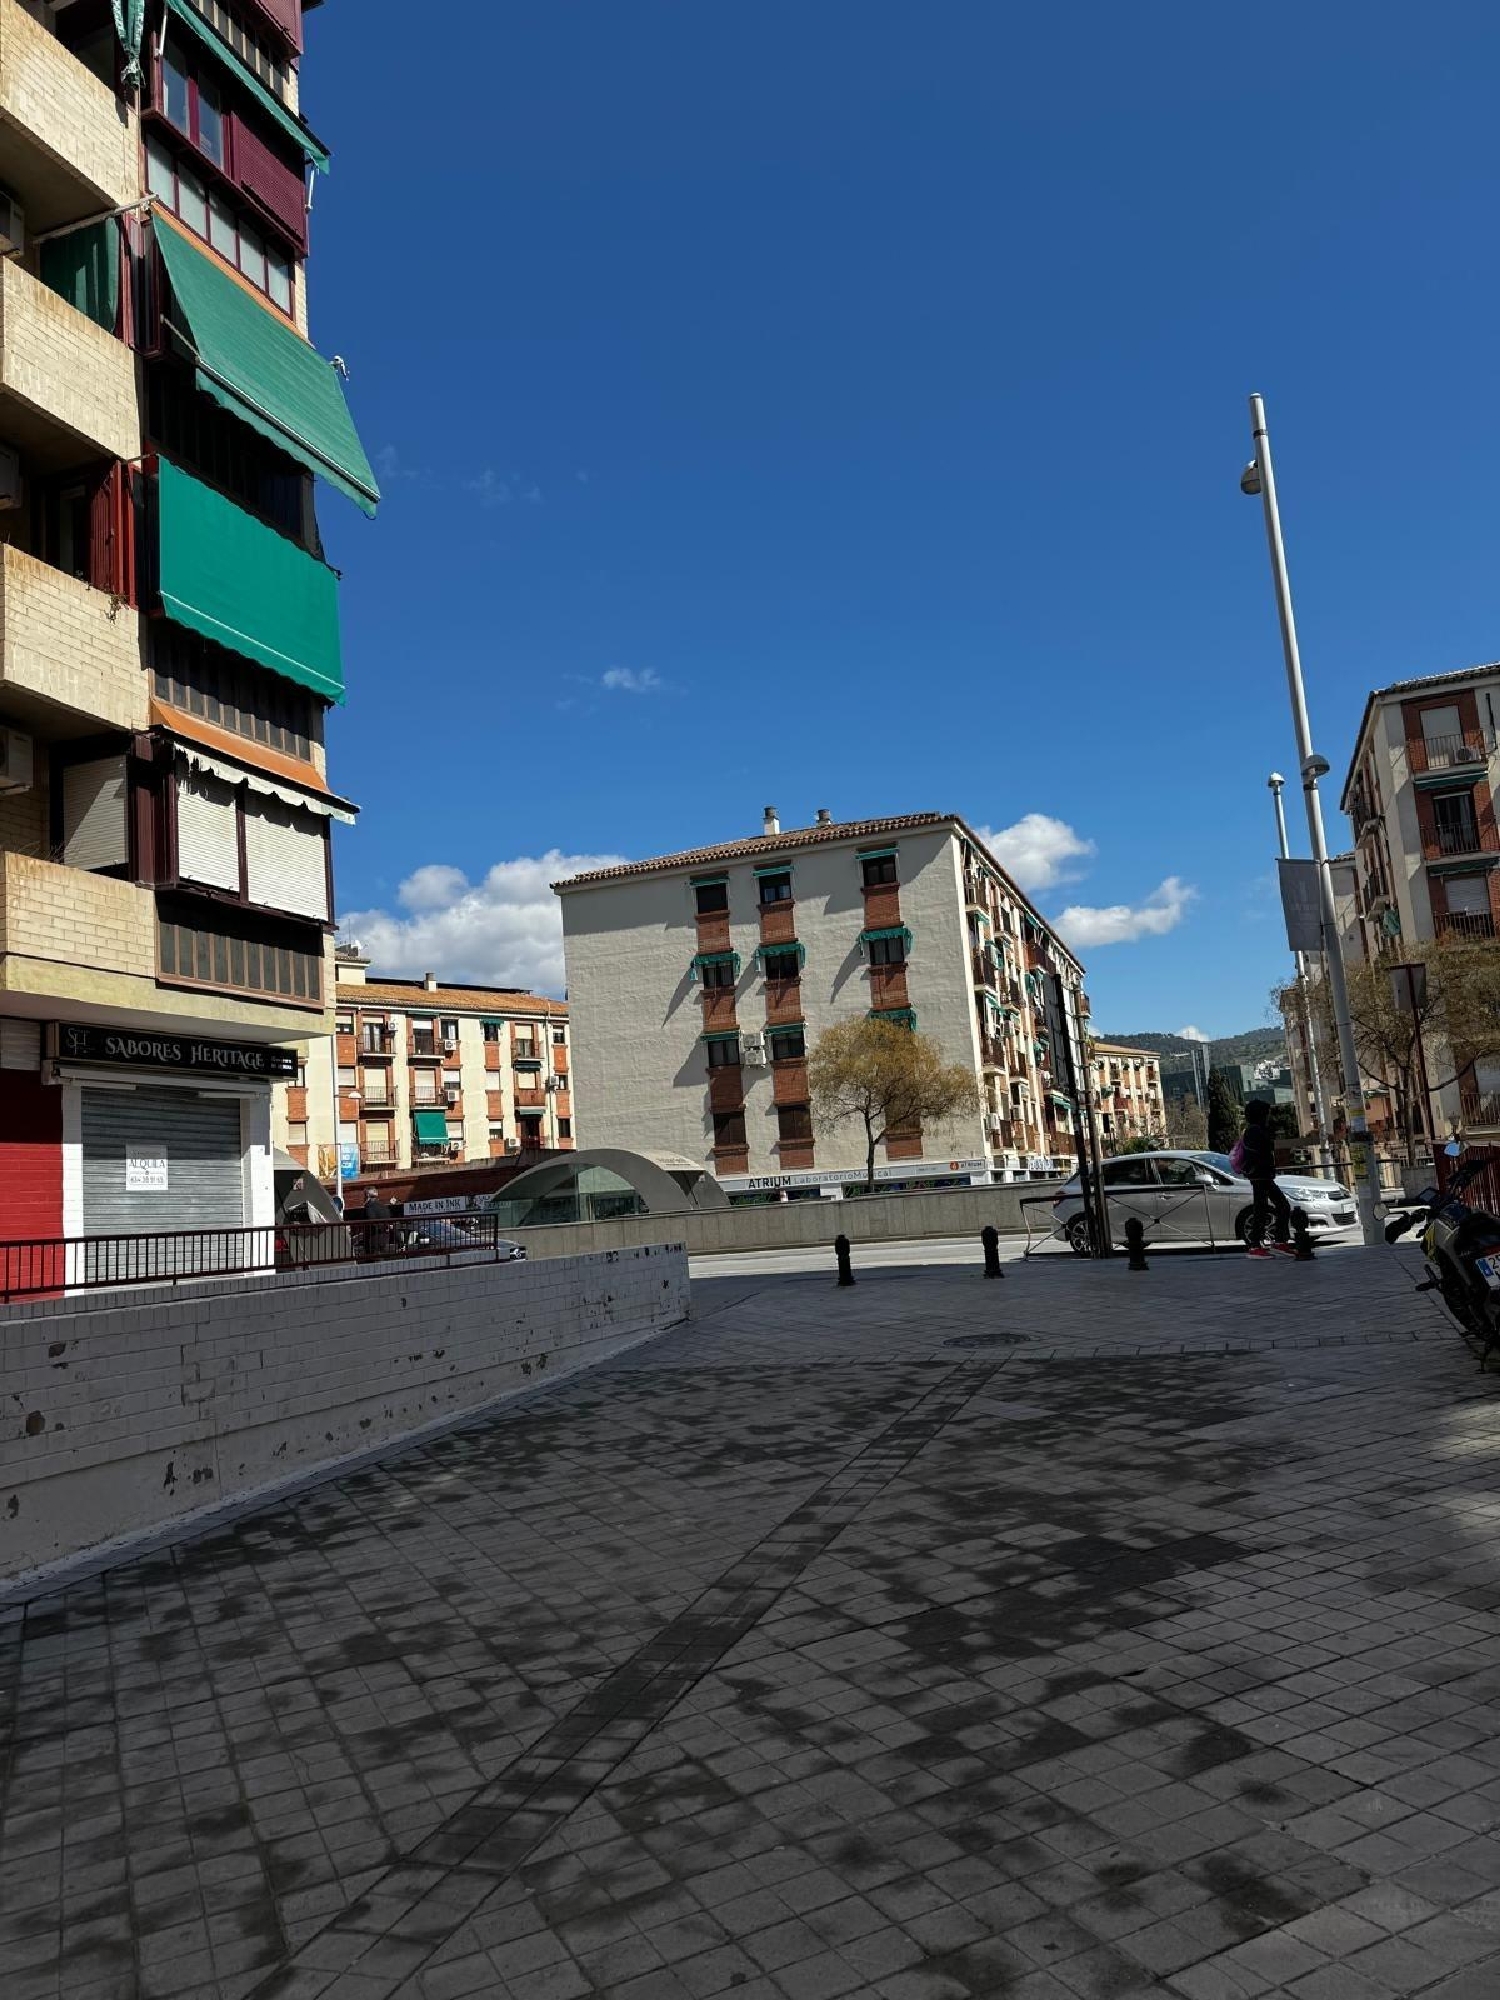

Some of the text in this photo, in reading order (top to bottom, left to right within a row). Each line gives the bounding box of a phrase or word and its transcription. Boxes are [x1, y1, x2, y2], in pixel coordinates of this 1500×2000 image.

[106, 1037, 181, 1062] SABORES
[190, 1044, 265, 1070] HERITAGE
[748, 1176, 791, 1189] ATRIUM
[409, 1202, 433, 1211] MADE
[435, 1200, 444, 1210] IN
